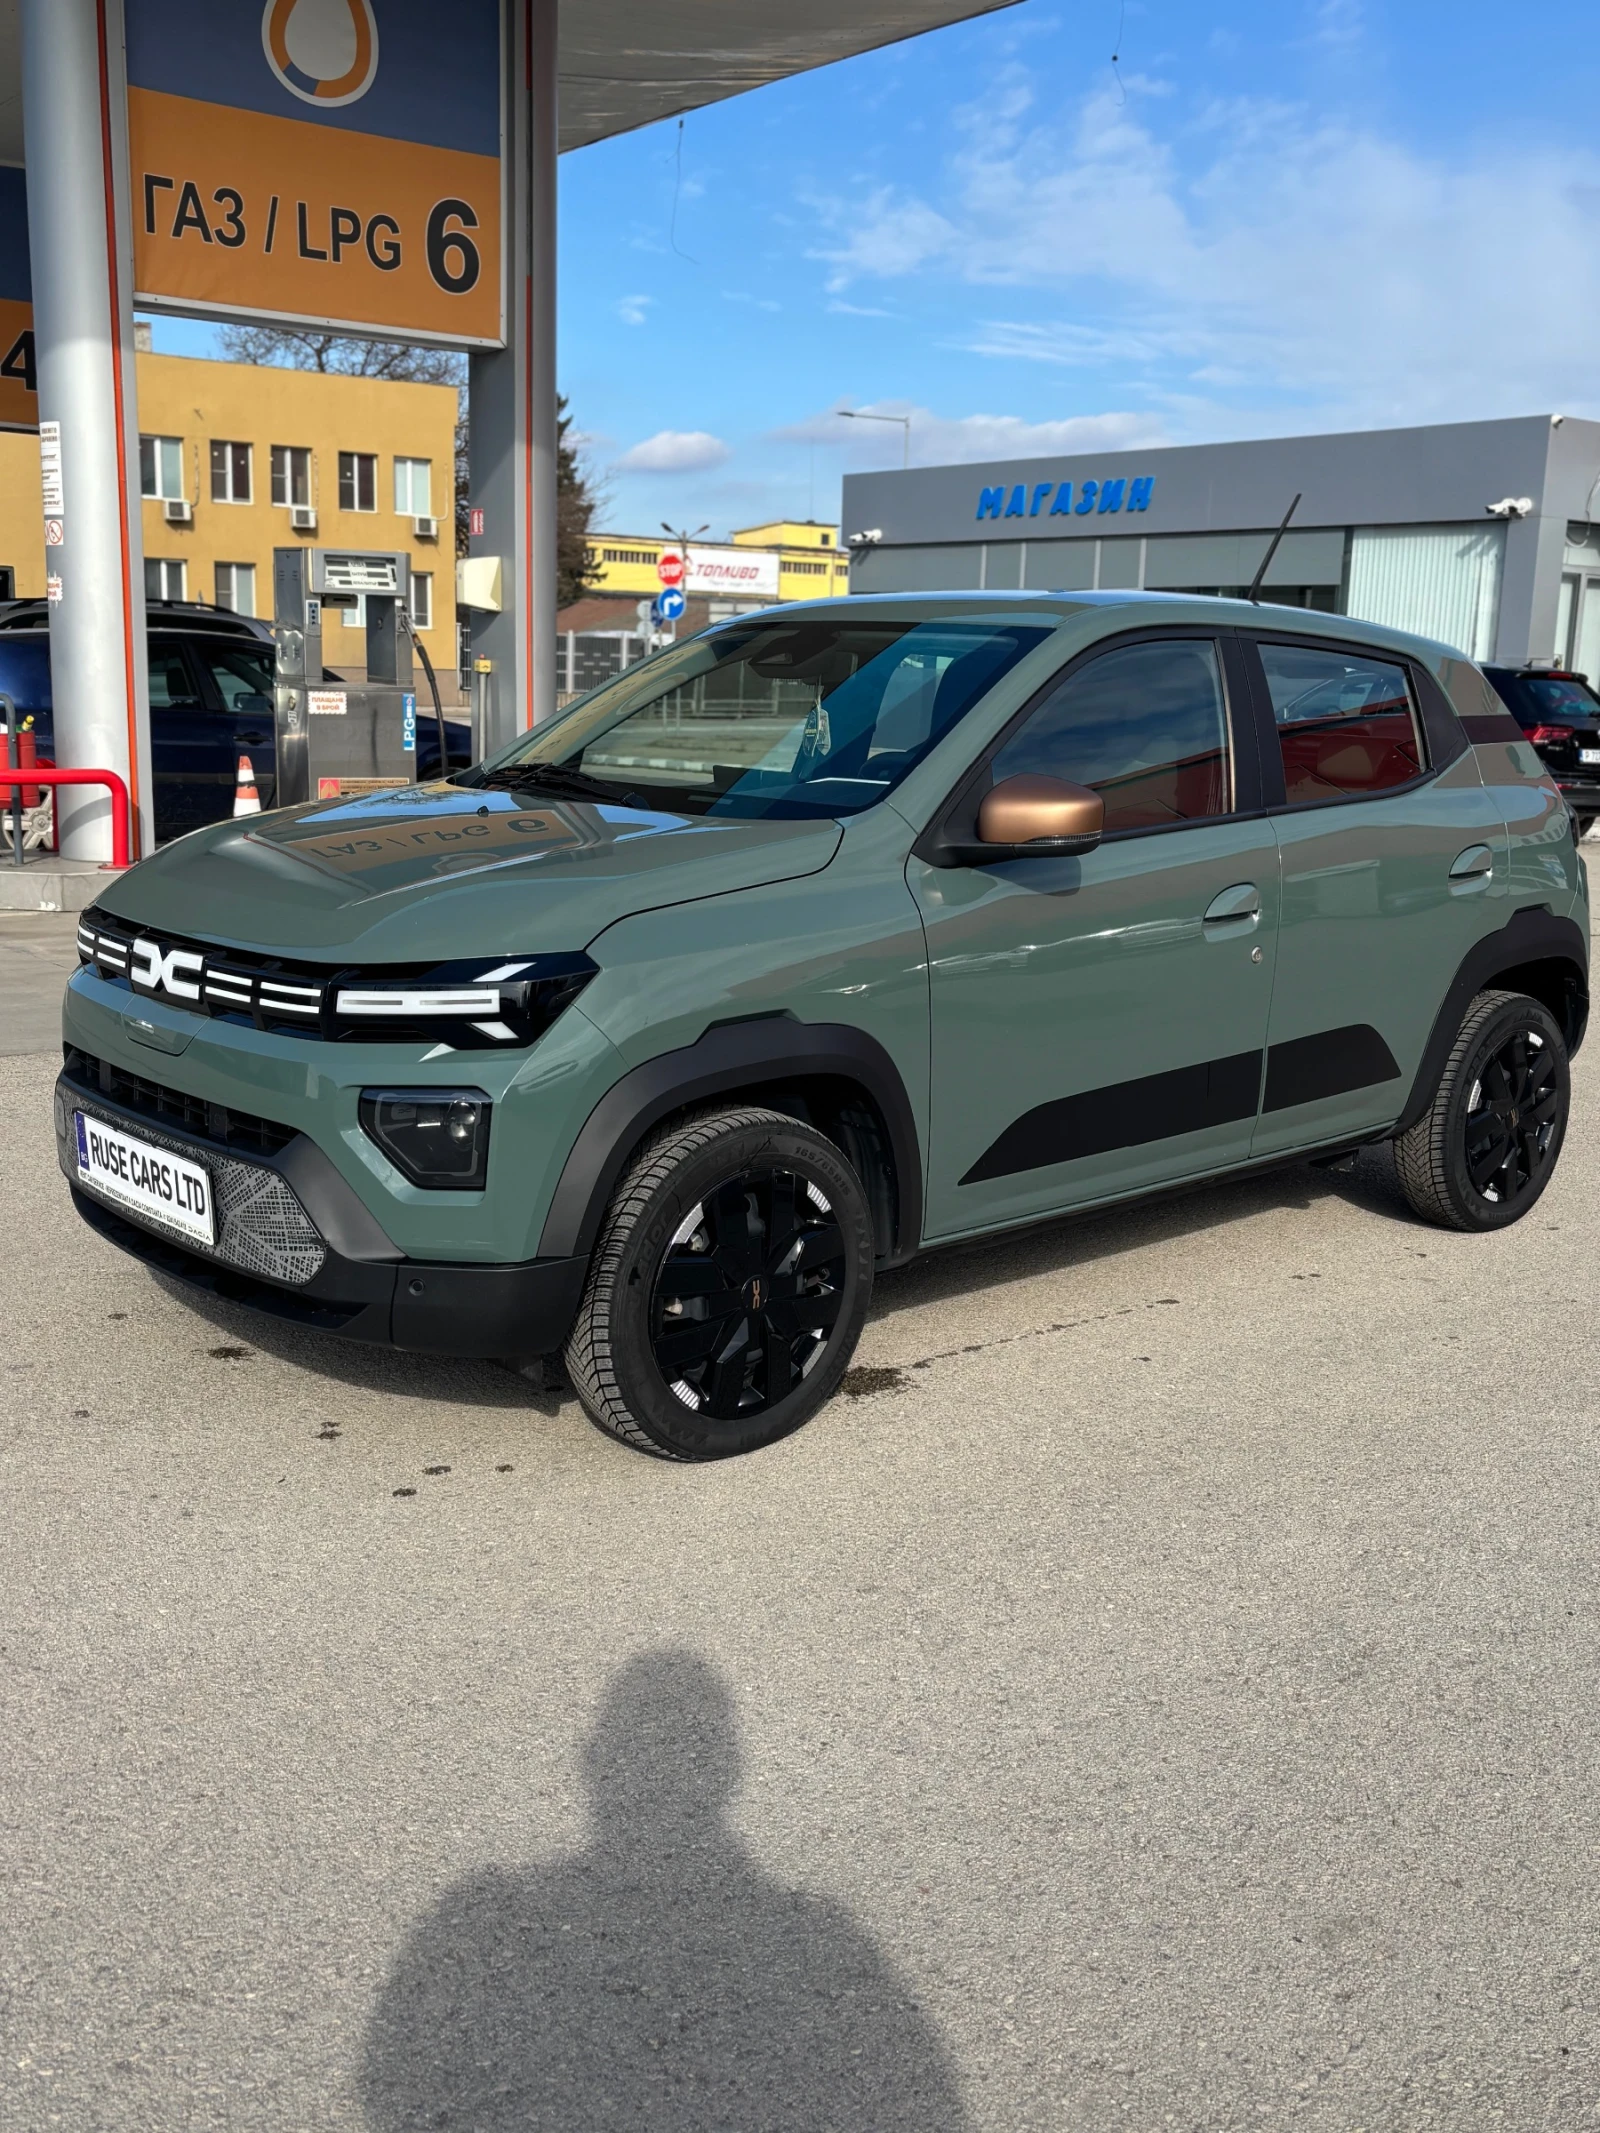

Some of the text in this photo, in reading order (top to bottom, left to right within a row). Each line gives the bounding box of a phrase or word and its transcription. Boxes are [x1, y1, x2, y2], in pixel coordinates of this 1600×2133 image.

[143, 173, 482, 296] ГАЗ / LPG 6
[0, 329, 38, 392] 4
[975, 475, 1157, 520] МАГАЗИН
[660, 563, 684, 579] STOP
[311, 697, 344, 706] ПЛАЩАНЕ
[403, 718, 415, 751] LPG
[80, 1151, 89, 1163] BG
[90, 1130, 206, 1216] RUSE CARS LTD
